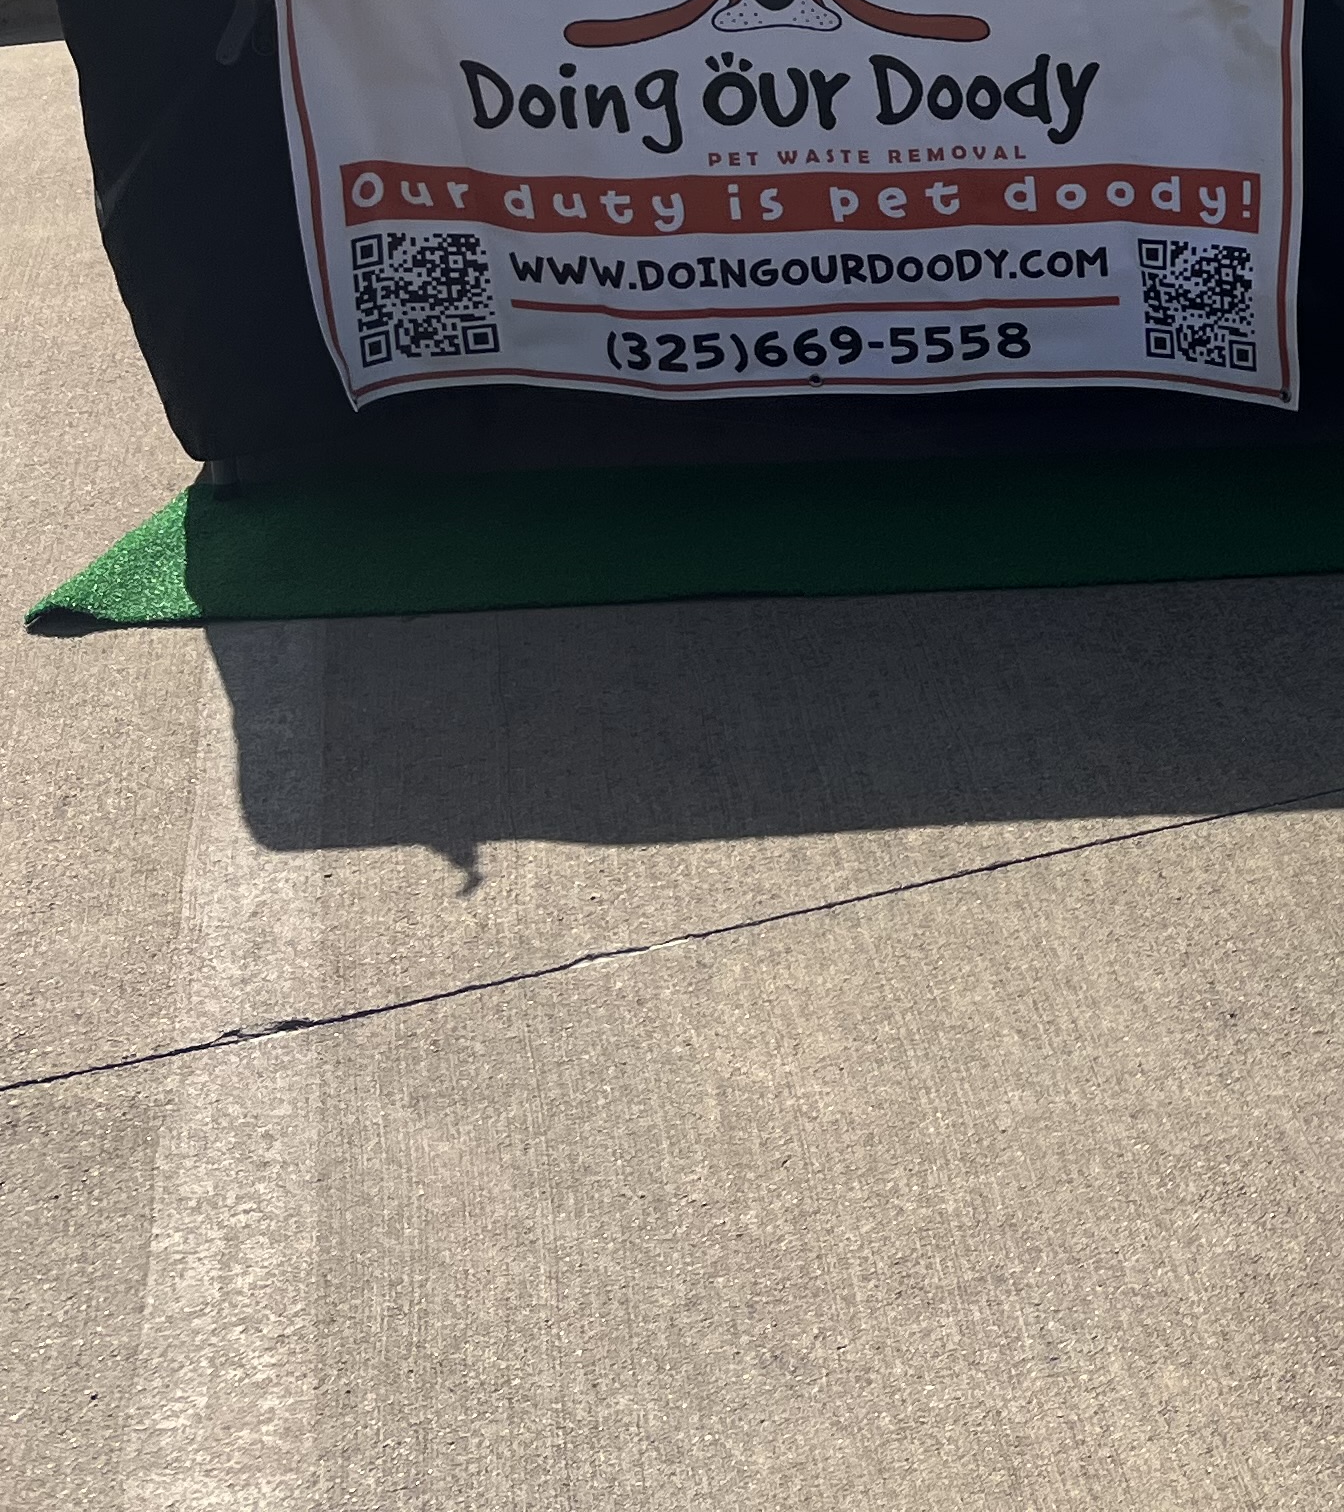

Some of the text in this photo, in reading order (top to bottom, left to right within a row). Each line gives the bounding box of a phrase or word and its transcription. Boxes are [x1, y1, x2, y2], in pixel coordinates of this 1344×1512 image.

[459, 60, 684, 154] Doing
[868, 53, 1100, 145] Doody
[707, 144, 1028, 168] PET WASTE REMOVAL
[351, 171, 1253, 233] Our duty is pet doody!
[508, 245, 1110, 292] WWW.DOINGOURDOODY.COM
[606, 321, 1032, 373] (325)669-5558
